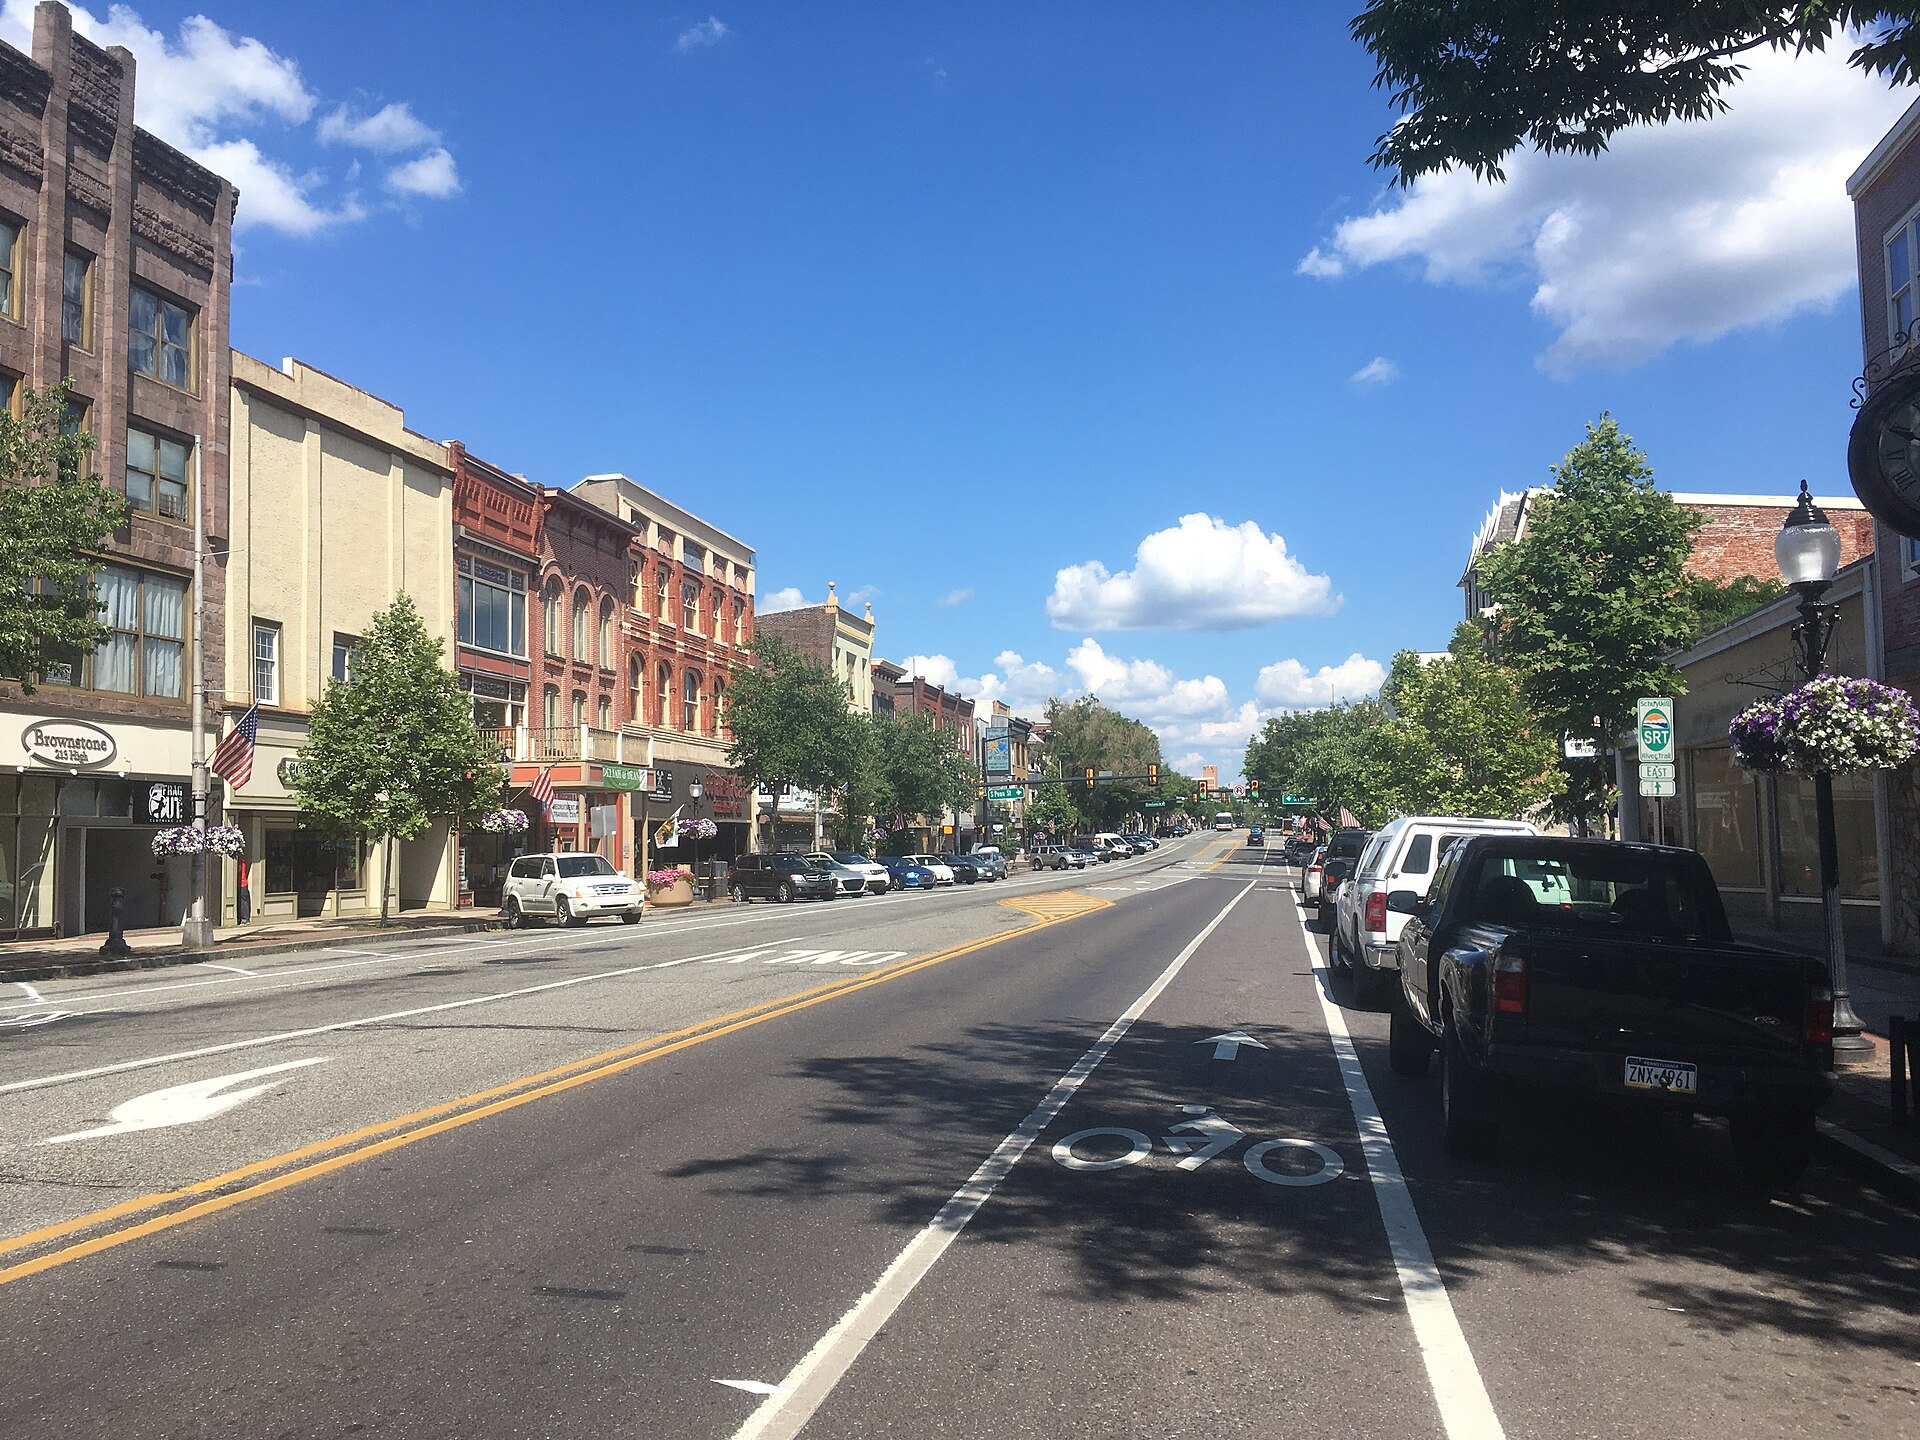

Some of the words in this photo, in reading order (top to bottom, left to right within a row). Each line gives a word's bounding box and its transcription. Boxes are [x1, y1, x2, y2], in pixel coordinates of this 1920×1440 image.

[1640, 700, 1671, 708] Schuylkill
[33, 728, 107, 752] Brownstone
[1644, 730, 1669, 744] SRT
[69, 749, 89, 764] High
[1647, 766, 1667, 777] EAST
[162, 785, 183, 796] FRAG
[702, 949, 909, 966] ONLY
